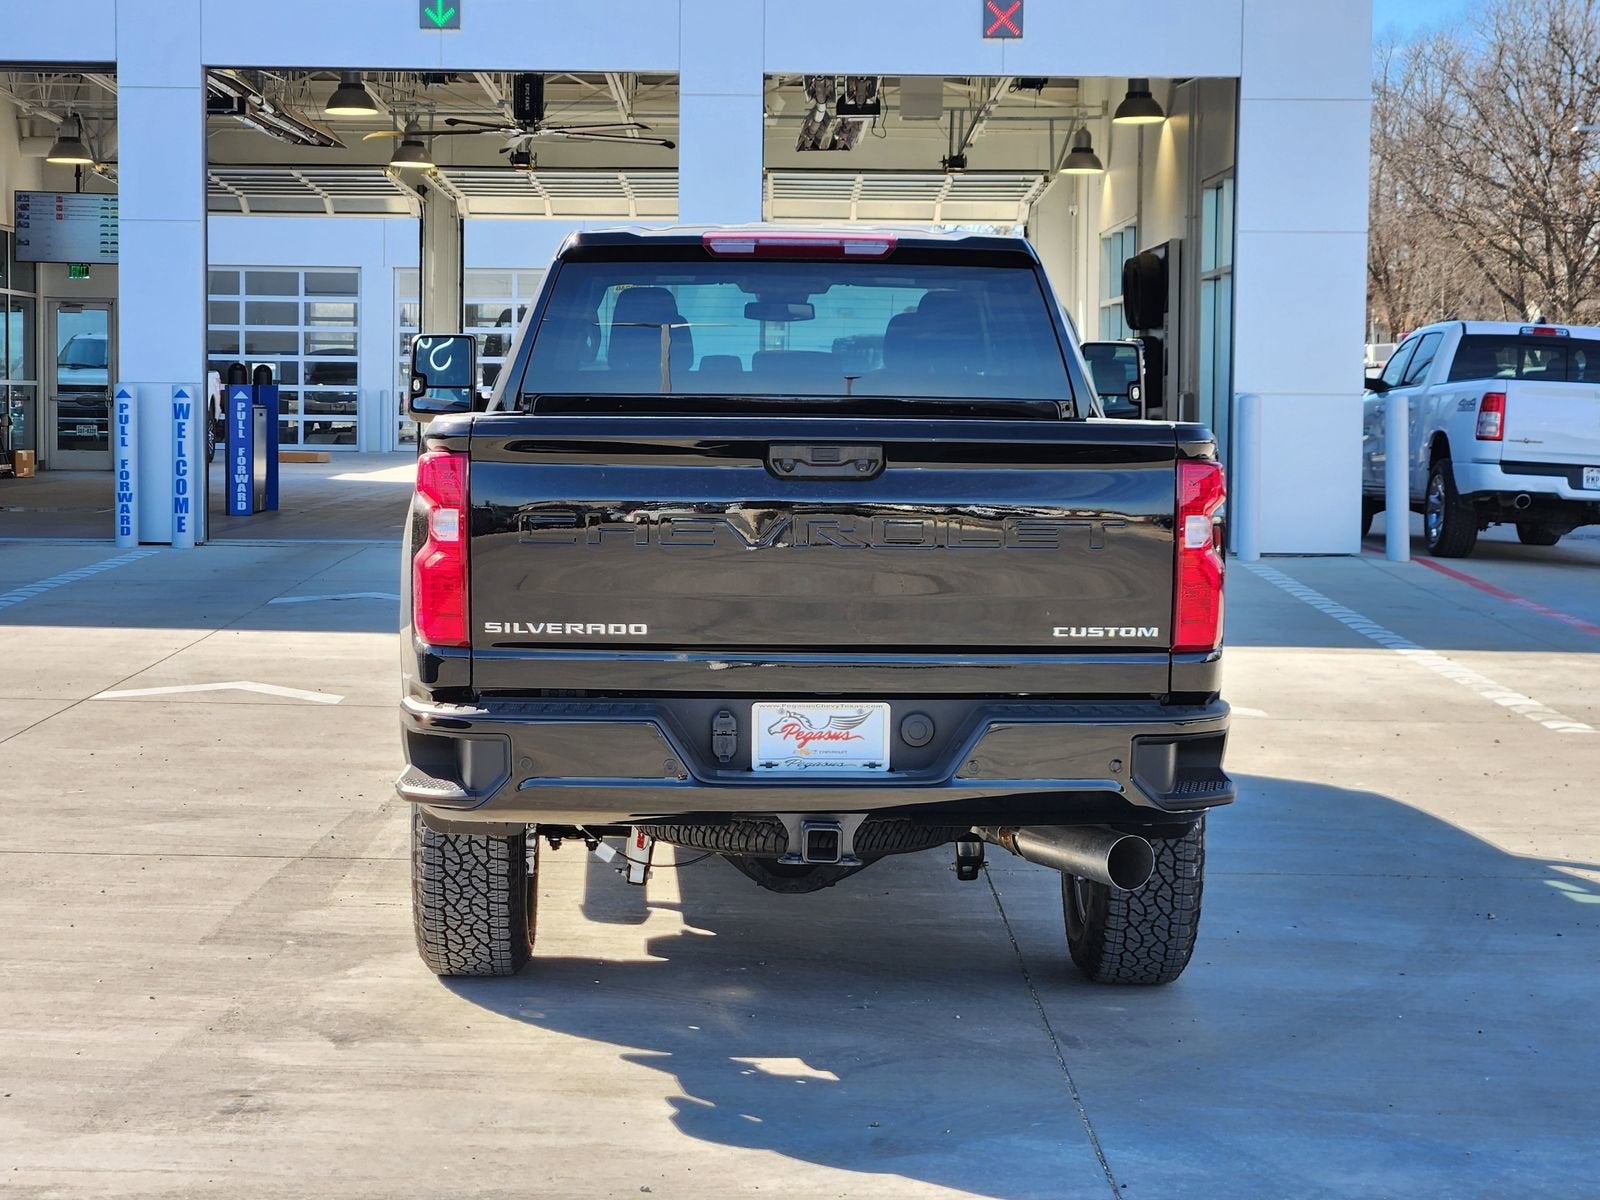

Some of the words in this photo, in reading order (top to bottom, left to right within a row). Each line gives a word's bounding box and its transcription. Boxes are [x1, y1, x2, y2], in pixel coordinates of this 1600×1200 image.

[118, 403, 130, 447] PULL
[236, 402, 247, 438] PULL
[173, 403, 191, 533] WELCOME
[234, 447, 249, 511] FORWARD
[117, 459, 133, 536] FORWARD
[518, 509, 1127, 551] CHEVROLET
[484, 622, 649, 635] SILVERADO
[1052, 626, 1159, 638] CUSTOM
[780, 723, 865, 749] Pegasus
